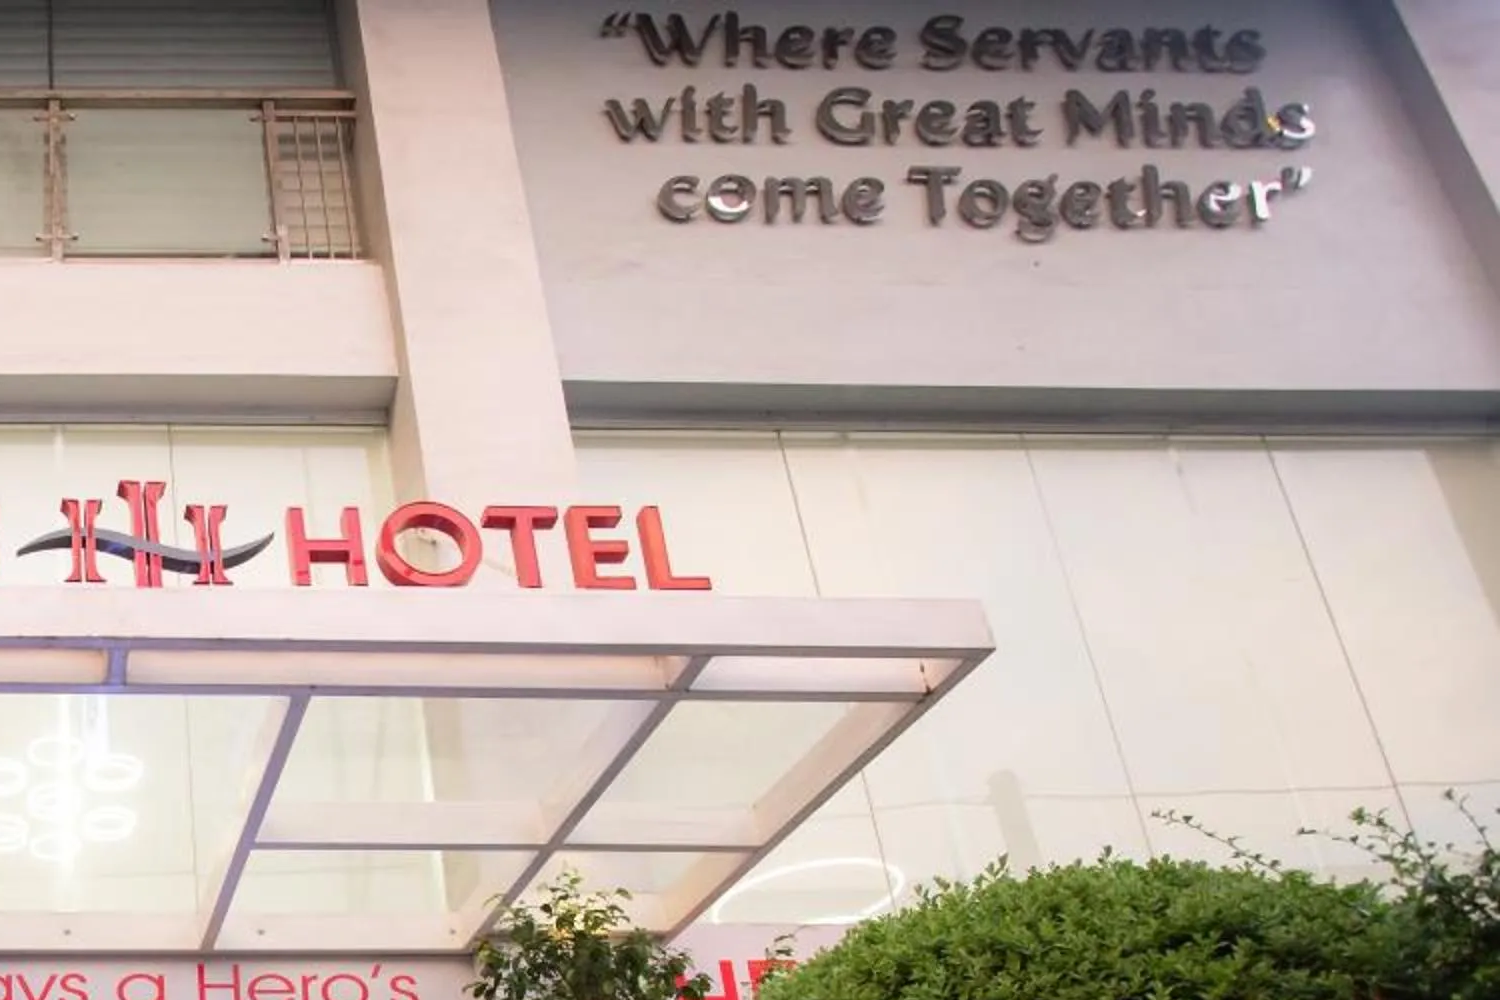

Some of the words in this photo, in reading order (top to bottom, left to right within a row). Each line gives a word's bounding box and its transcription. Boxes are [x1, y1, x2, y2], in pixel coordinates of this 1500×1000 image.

[919, 15, 1267, 72] Servants
[604, 83, 790, 144] with
[815, 86, 1042, 146] Great
[1064, 88, 1317, 150] Minds
[657, 173, 886, 224] come
[286, 501, 713, 591] HOTEL
